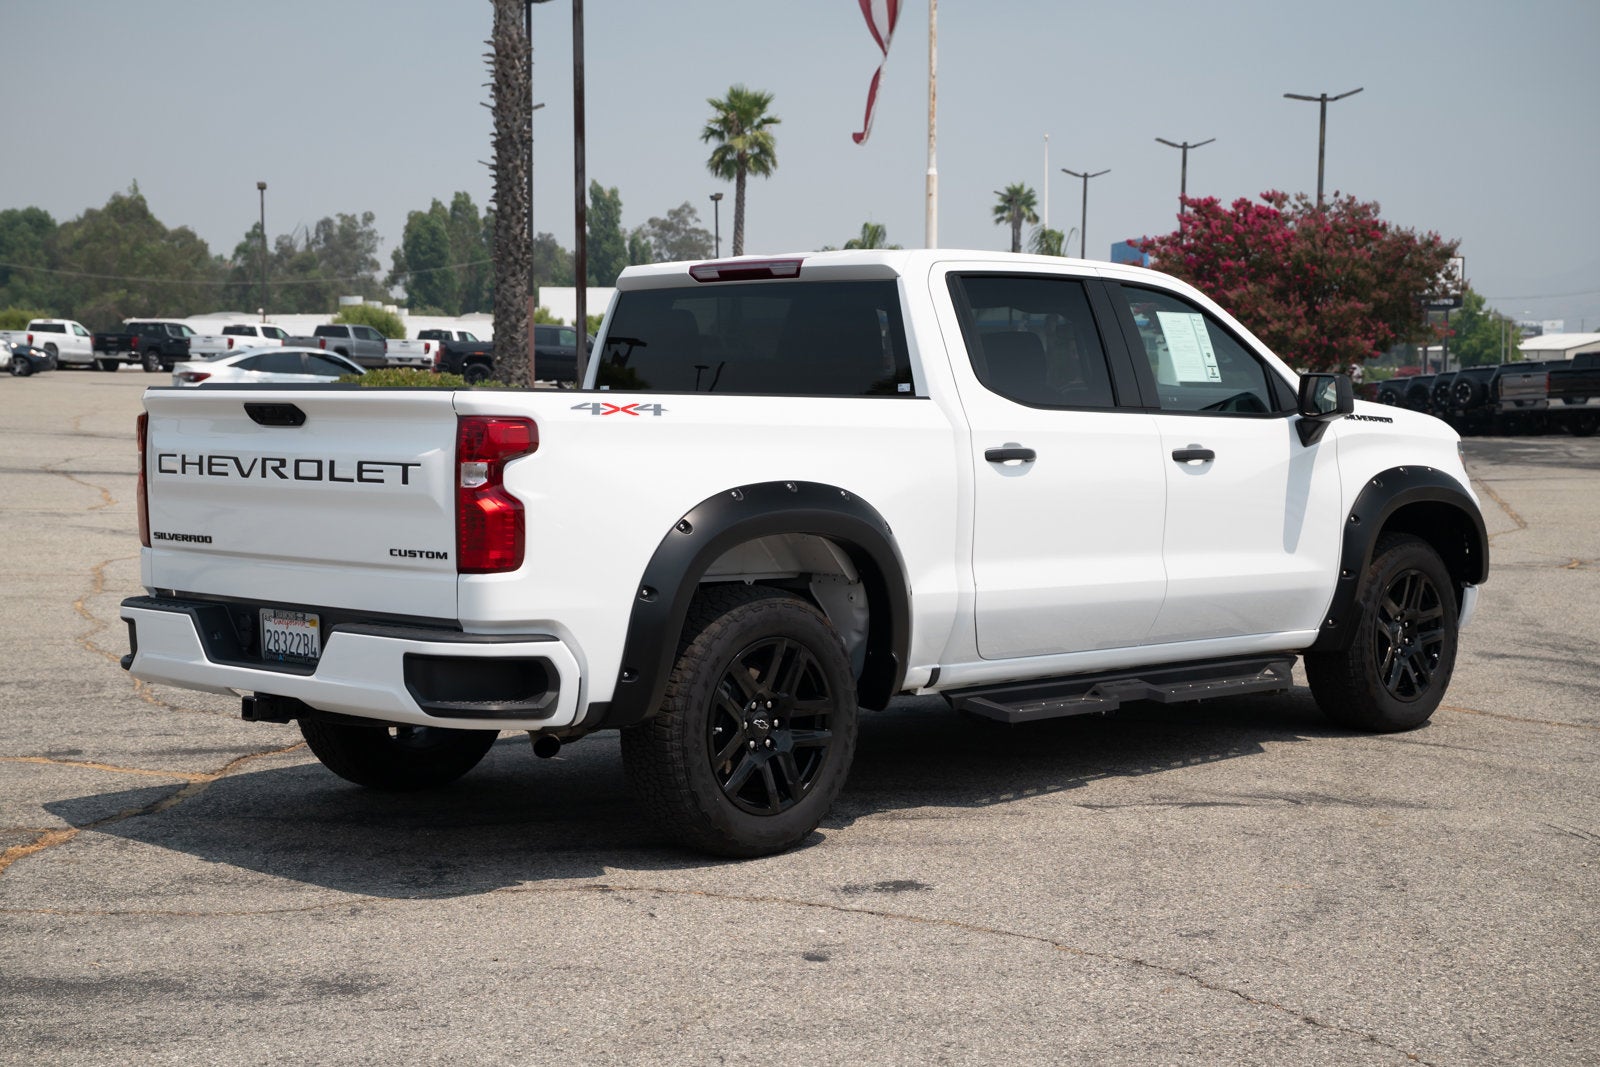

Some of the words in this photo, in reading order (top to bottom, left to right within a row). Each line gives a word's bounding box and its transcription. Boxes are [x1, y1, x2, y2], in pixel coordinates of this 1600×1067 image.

[158, 453, 422, 486] CHEVROLET
[153, 531, 213, 544] SILVERADO
[389, 548, 449, 560] CUSTOM
[266, 629, 318, 658] 28322B4
